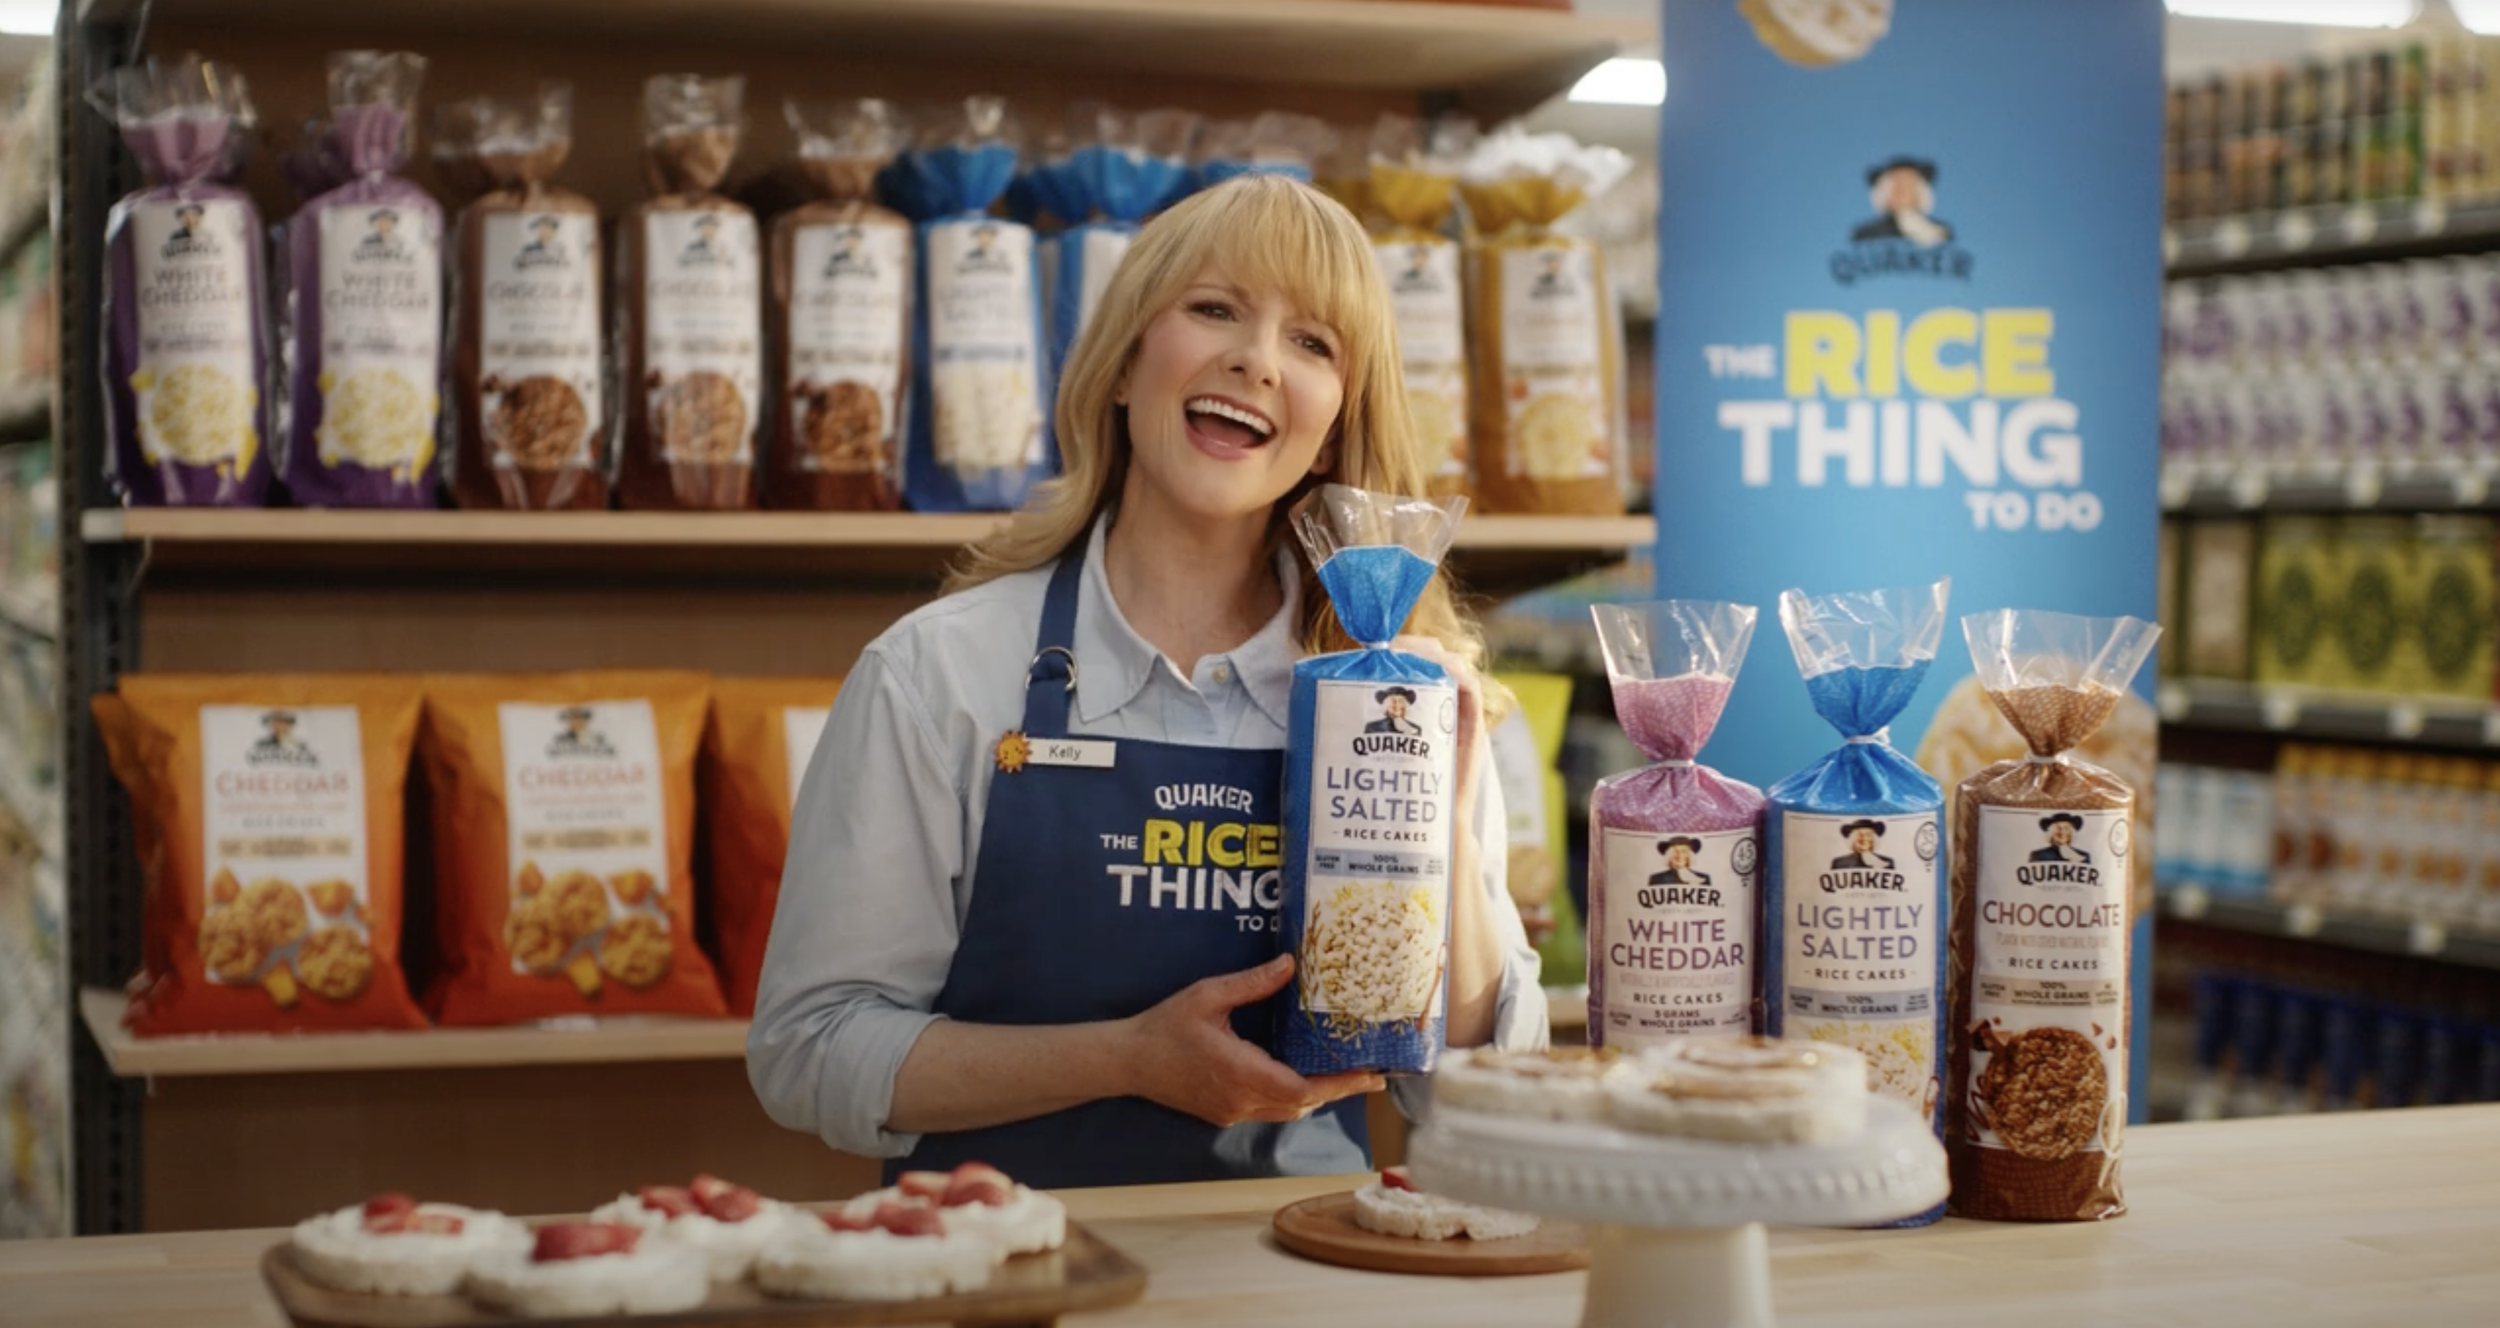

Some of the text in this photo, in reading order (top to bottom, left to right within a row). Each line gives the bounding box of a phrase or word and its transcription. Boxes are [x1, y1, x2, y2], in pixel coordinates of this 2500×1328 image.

[1829, 243, 1976, 288] QUAKER
[1704, 307, 2055, 400] THE RICE
[1717, 399, 2084, 489] THING
[1964, 490, 2104, 532] TO DO
[1049, 745, 1082, 761] Kelly
[1352, 735, 1430, 759] QUAKER
[214, 770, 351, 797] CHEDDAR
[518, 763, 647, 790] CHEDDAR
[1327, 766, 1443, 795] LIGHTLY
[1153, 783, 1254, 815] QUAKER
[1330, 795, 1437, 823] SALTED
[1100, 818, 1284, 868] THE RICE
[1343, 828, 1428, 843] RICE CAKES
[1348, 862, 1383, 872] WHOLE
[1386, 864, 1420, 874] GRAINS
[1373, 854, 1399, 864] 100%
[1819, 871, 1905, 893] QUAKER
[2016, 864, 2099, 886] QUAKER
[1106, 864, 1282, 911] THING
[1637, 888, 1721, 908] QUAKER
[1235, 914, 1281, 932] TO D
[1797, 903, 1923, 930] LIGHTLY
[1982, 900, 2120, 928] CHOCOLATE
[1627, 917, 1726, 943] WHITE
[1610, 942, 1745, 971] CHEDDAR
[1802, 934, 1917, 960] SALTED
[1815, 968, 1907, 981] RICE CAKES
[2009, 957, 2099, 970] RICE CAKES
[2014, 990, 2050, 999] WHOLE
[2053, 990, 2090, 999] GRAINS
[2039, 981, 2067, 989] 100%
[1633, 992, 1723, 1005] RICE CAKES
[1822, 1004, 1898, 1014] WHOLE GRAINS
[1846, 995, 1874, 1005] 100%
[1640, 1018, 1715, 1028] WHOLE GRAINS
[1663, 1009, 1701, 1018] GRAMS
